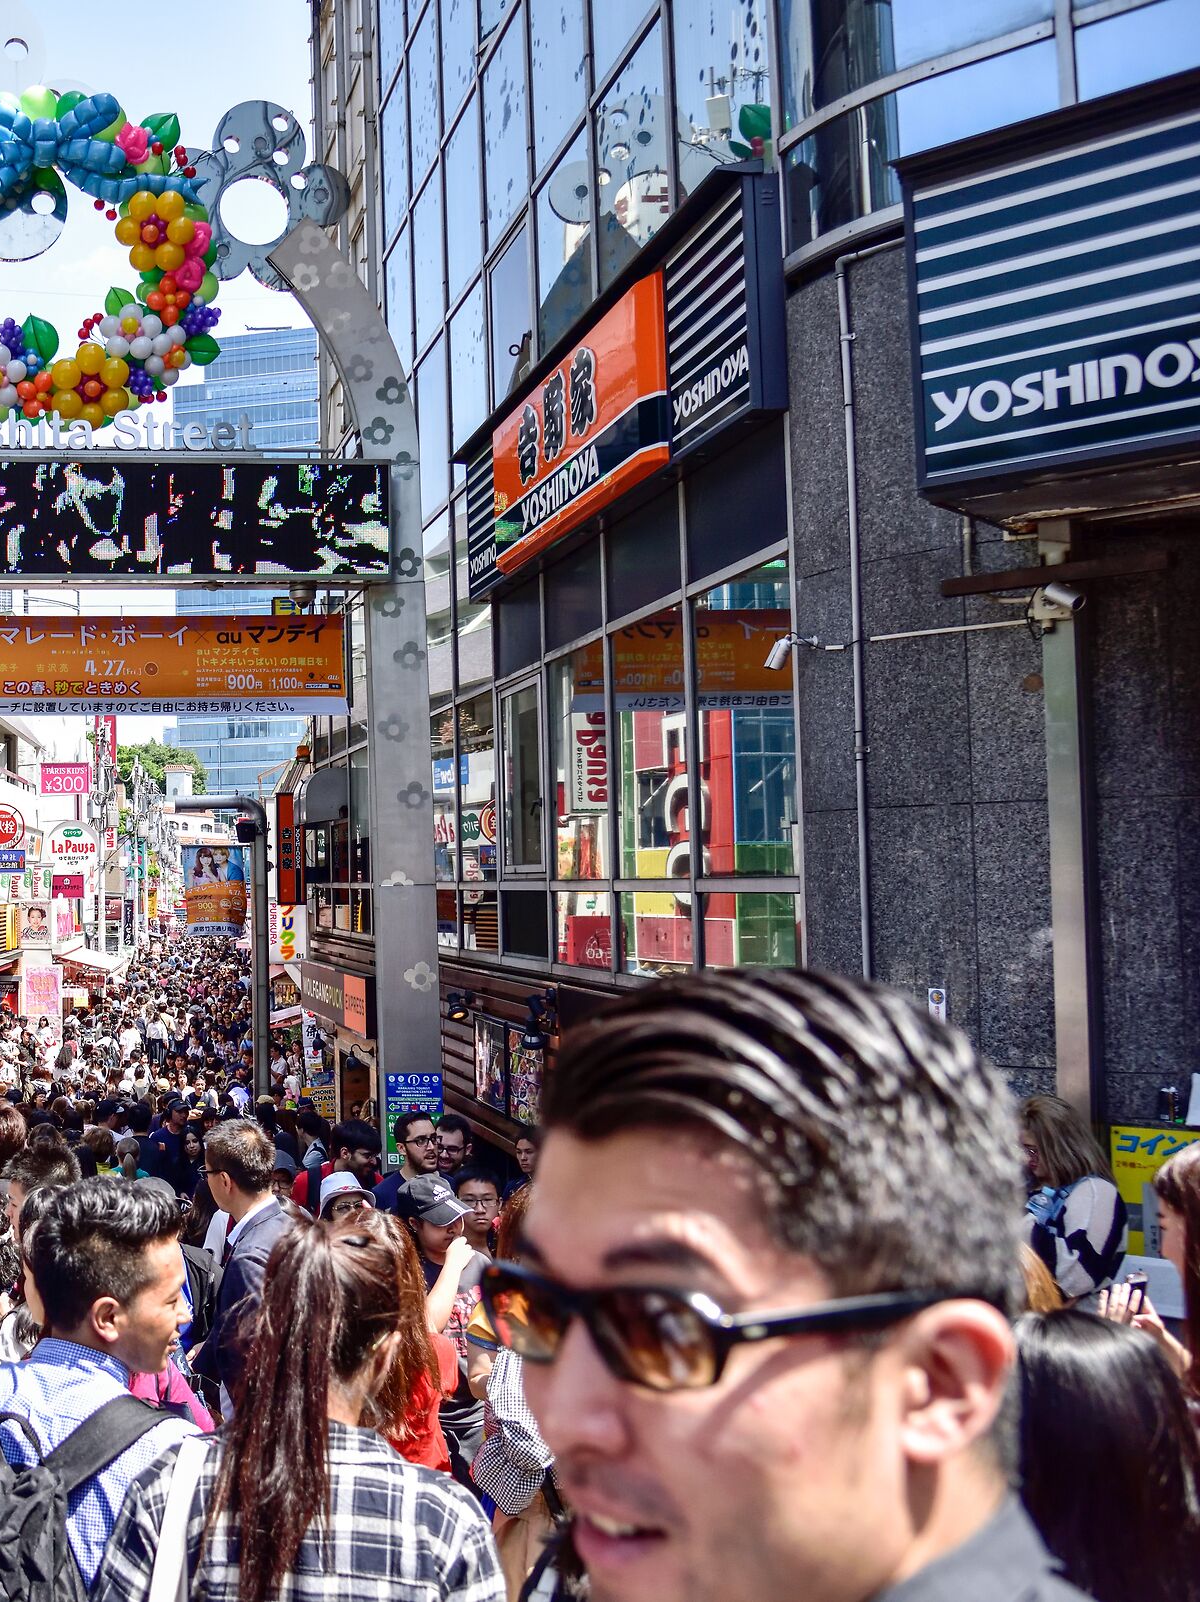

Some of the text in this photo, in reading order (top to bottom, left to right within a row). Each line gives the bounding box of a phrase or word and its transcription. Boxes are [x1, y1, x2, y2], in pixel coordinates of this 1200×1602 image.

[673, 344, 750, 426] YOSHINOYA
[113, 410, 257, 452] Street
[517, 345, 597, 487] 吉野家
[520, 450, 600, 533] YOSHINOYA
[216, 623, 325, 644] au マンデイ
[3, 680, 142, 695] この春、秒でときめく
[45, 776, 84, 792] ¥300
[52, 840, 96, 855] La Pausa
[269, 902, 277, 946] PURIKURA
[1116, 1133, 1199, 1157] コイン
